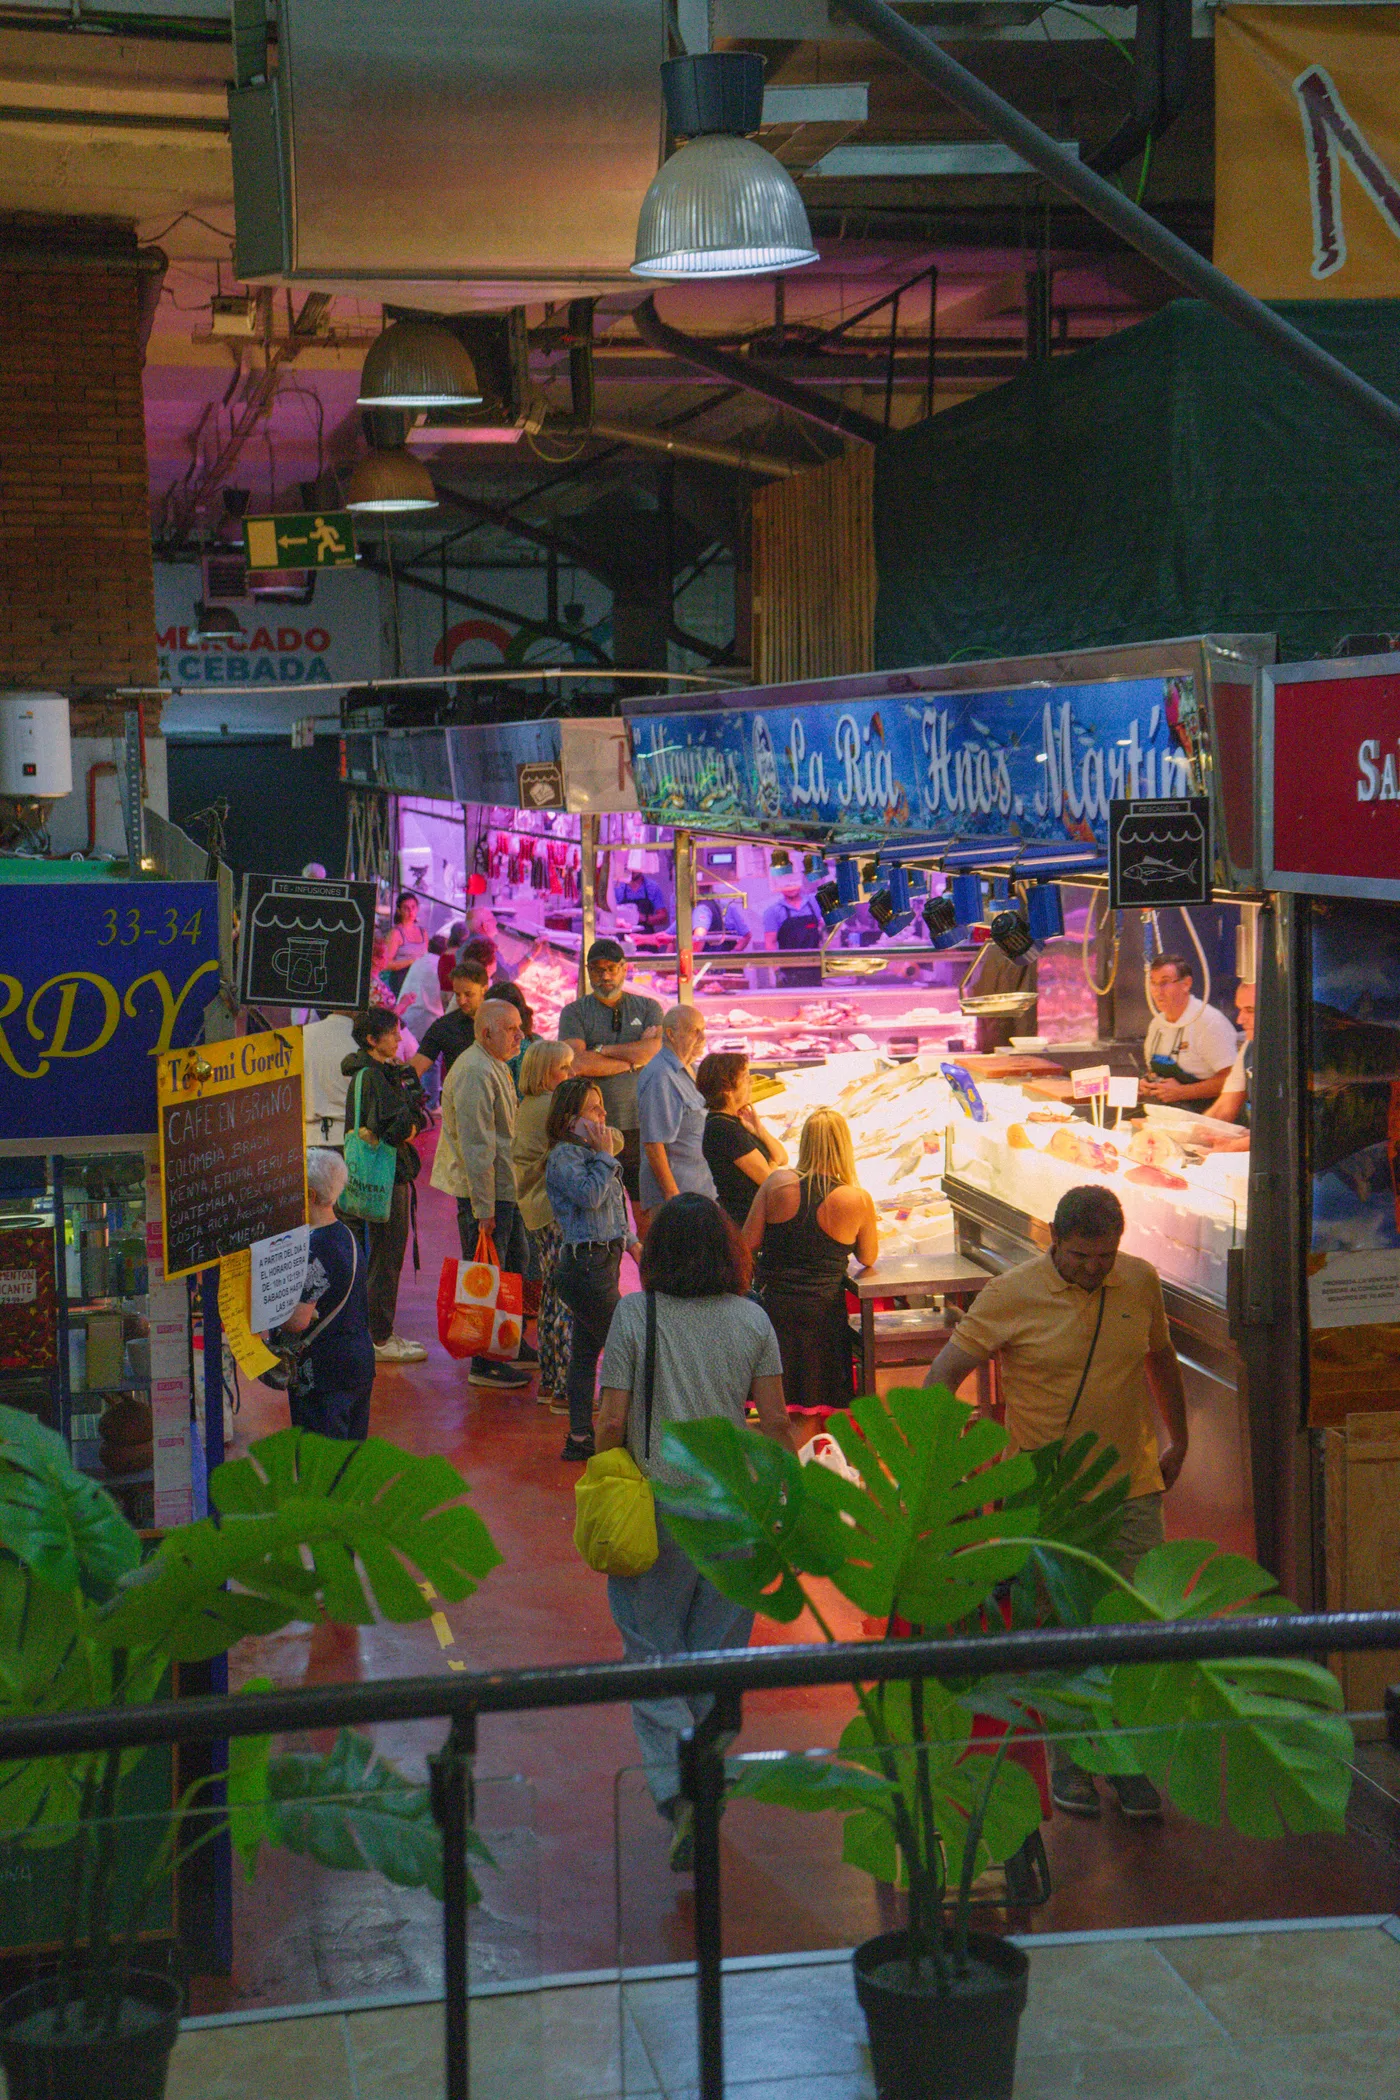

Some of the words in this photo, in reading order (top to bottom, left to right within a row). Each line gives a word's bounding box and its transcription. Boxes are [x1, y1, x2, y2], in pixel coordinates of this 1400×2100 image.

[156, 626, 331, 652] MECADO
[178, 655, 332, 681] CEBADA
[792, 718, 830, 805] La
[922, 704, 1024, 816] Hnos.
[1358, 739, 1400, 802] SA
[295, 886, 341, 896] INFUSIONES
[97, 907, 203, 945] 33-34
[212, 1052, 236, 1083] mi
[241, 1043, 293, 1077] Gordy
[168, 1103, 213, 1145] CAFE
[219, 1099, 236, 1133] EN
[264, 1251, 283, 1266] PARTIR
[283, 1248, 294, 1259] DEL
[260, 1270, 269, 1280] EL
[269, 1261, 292, 1277] HORARIO
[263, 1287, 289, 1304] SABADOS
